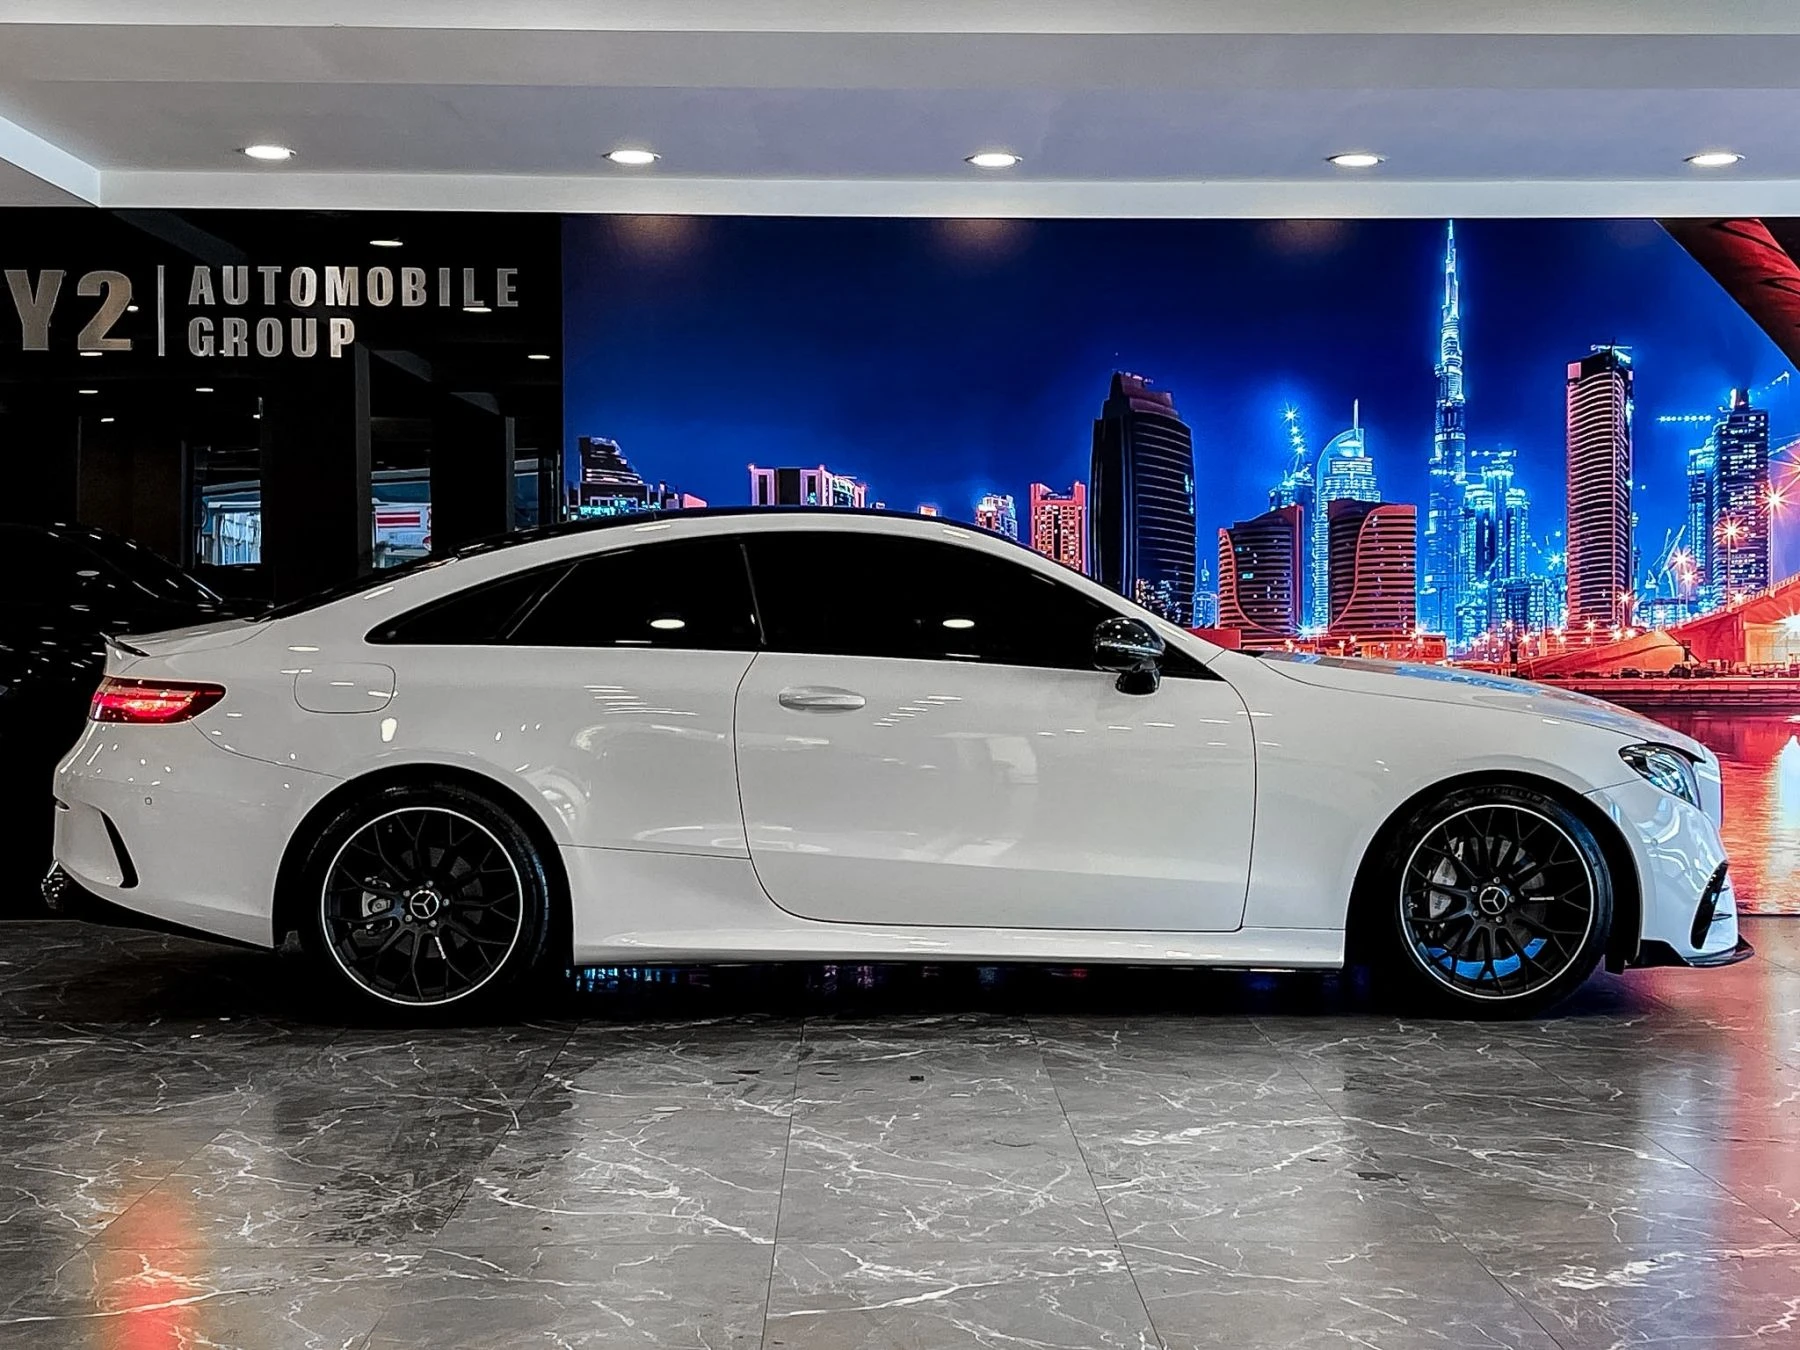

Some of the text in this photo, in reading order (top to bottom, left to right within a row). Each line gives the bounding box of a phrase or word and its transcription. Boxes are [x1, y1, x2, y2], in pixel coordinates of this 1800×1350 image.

[188, 265, 519, 307] AUTOMOBILE
[4, 269, 133, 351] Y2
[188, 316, 355, 357] GROUP
